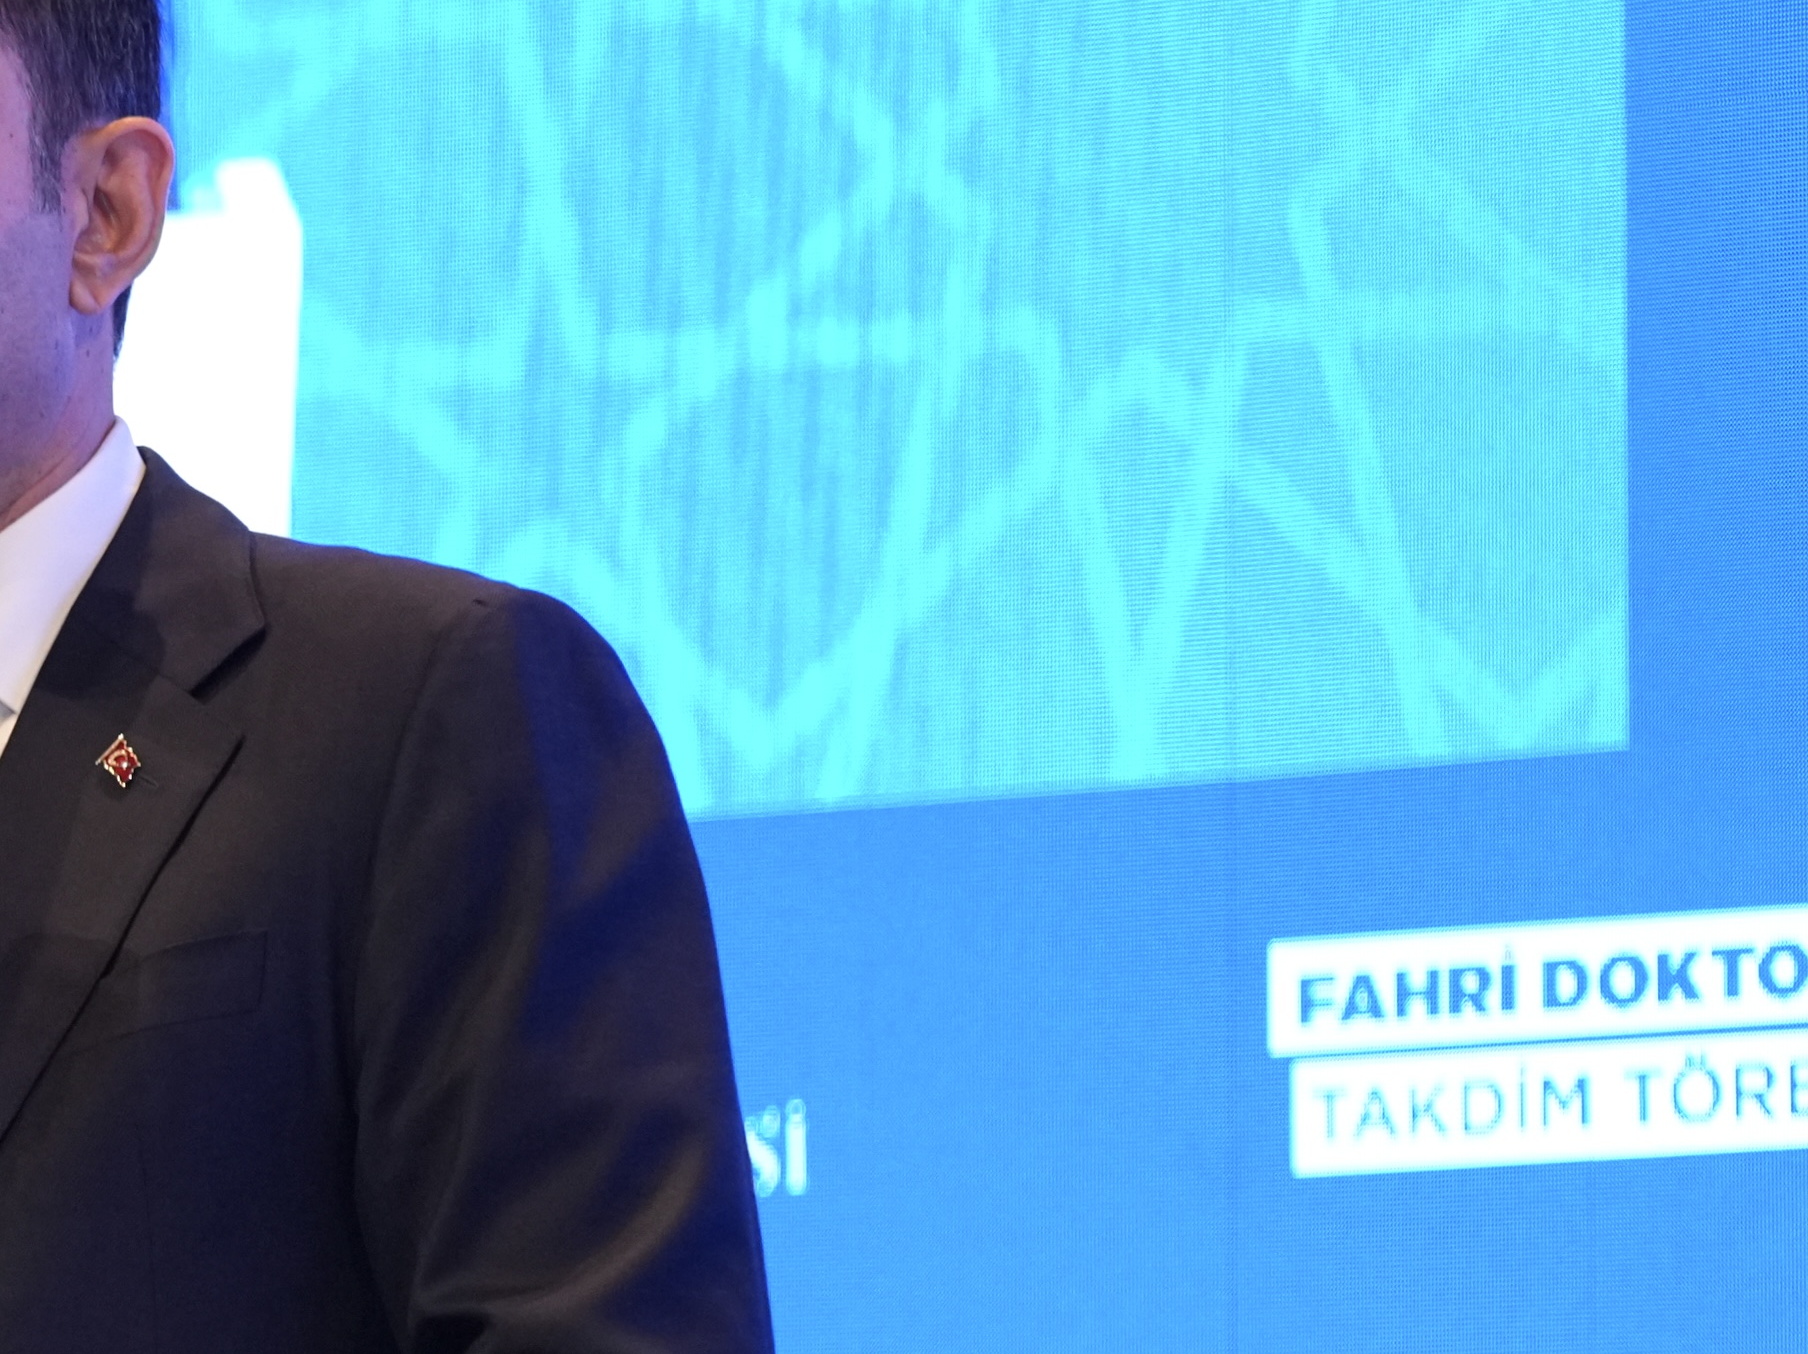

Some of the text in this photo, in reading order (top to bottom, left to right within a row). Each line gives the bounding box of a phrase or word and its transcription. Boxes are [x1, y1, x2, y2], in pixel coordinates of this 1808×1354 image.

[1300, 940, 1808, 1025] FAHRİ DOKTO
[1312, 1061, 1590, 1140] TAKDİM
